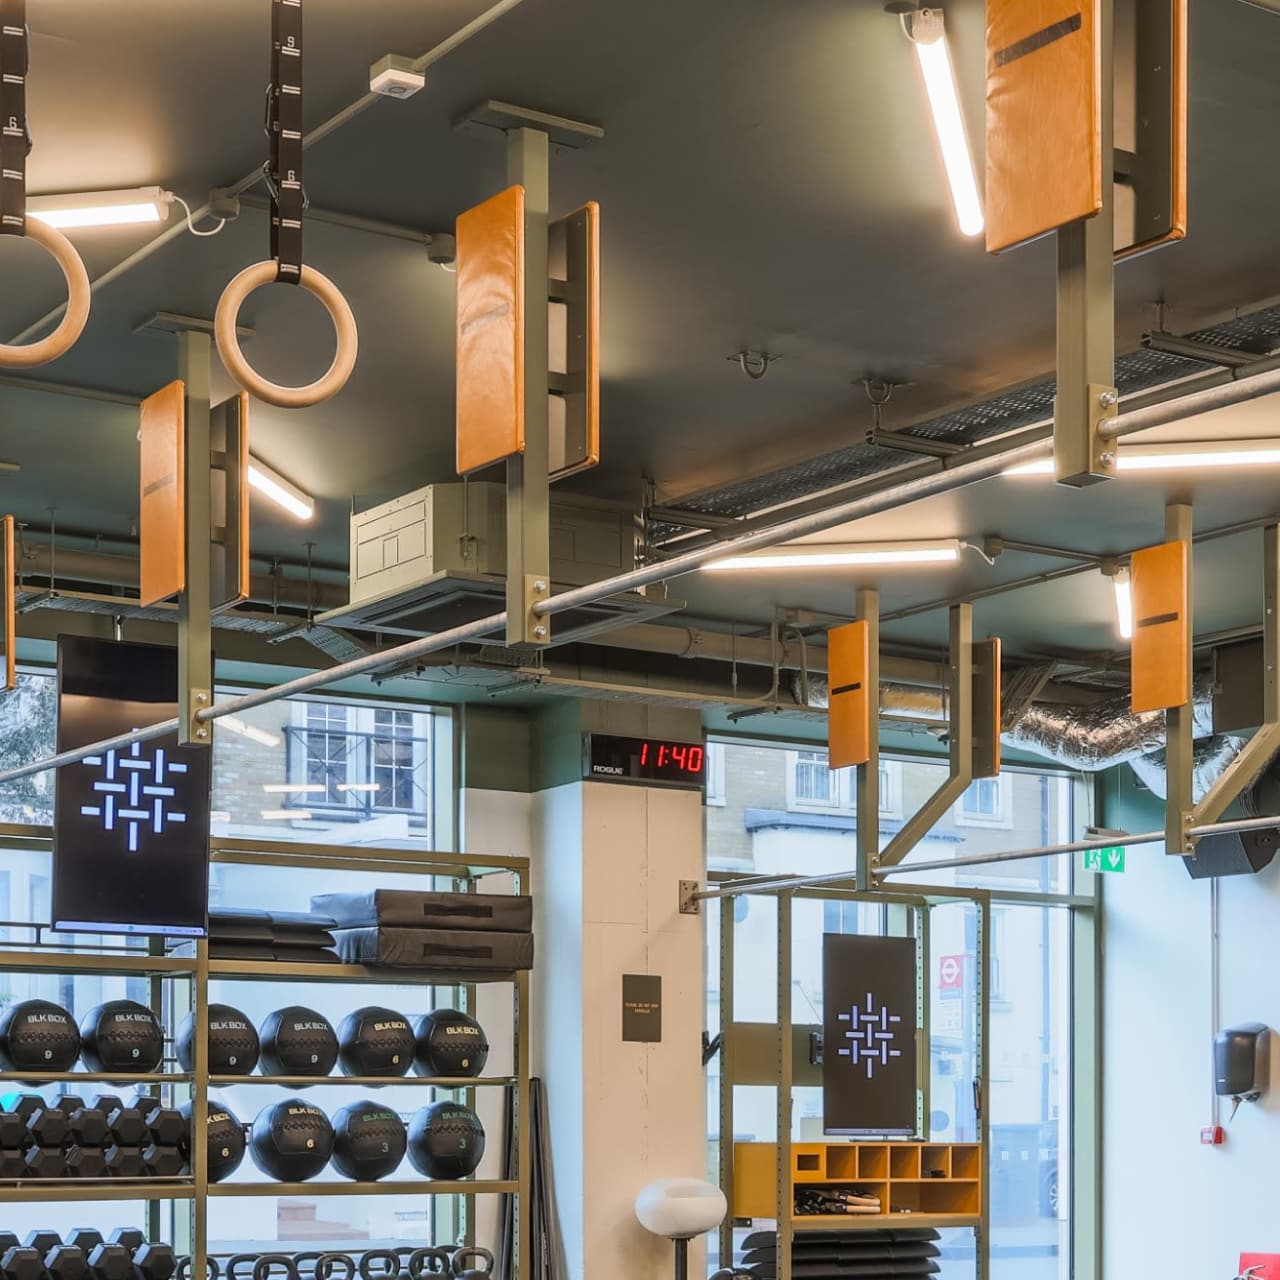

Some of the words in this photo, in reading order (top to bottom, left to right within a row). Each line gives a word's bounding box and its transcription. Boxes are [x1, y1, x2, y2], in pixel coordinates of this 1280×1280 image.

[287, 35, 295, 47] 9
[9, 116, 17, 128] 6
[287, 169, 295, 181] 6
[640, 743, 704, 773] 11:40
[593, 765, 624, 775] ROGUE
[28, 1014, 47, 1024] BLK
[47, 1014, 67, 1024] BOX
[115, 1014, 135, 1022] BLK
[135, 1014, 152, 1022] BOX
[210, 1021, 229, 1030] BLK
[229, 1021, 247, 1030] BOX
[294, 1022, 312, 1031] BLK
[312, 1022, 328, 1031] BOX
[374, 1022, 391, 1031] BLK
[391, 1021, 407, 1030] BOX
[446, 1026, 464, 1035] BLK
[464, 1026, 479, 1035] BOX
[45, 1050, 53, 1059] 9
[132, 1048, 140, 1057] 9
[229, 1056, 237, 1065] 9
[311, 1054, 318, 1063] 9
[392, 1055, 399, 1064] 6
[462, 1059, 469, 1068] 6
[288, 1107, 307, 1115] BLK
[307, 1107, 322, 1116] BOX
[214, 1113, 231, 1122] BOX
[363, 1113, 381, 1122] BLK
[381, 1112, 395, 1121] BOX
[306, 1138, 314, 1148] 6
[381, 1142, 389, 1152] 3
[459, 1138, 466, 1149] 3
[222, 1148, 229, 1157] 6
